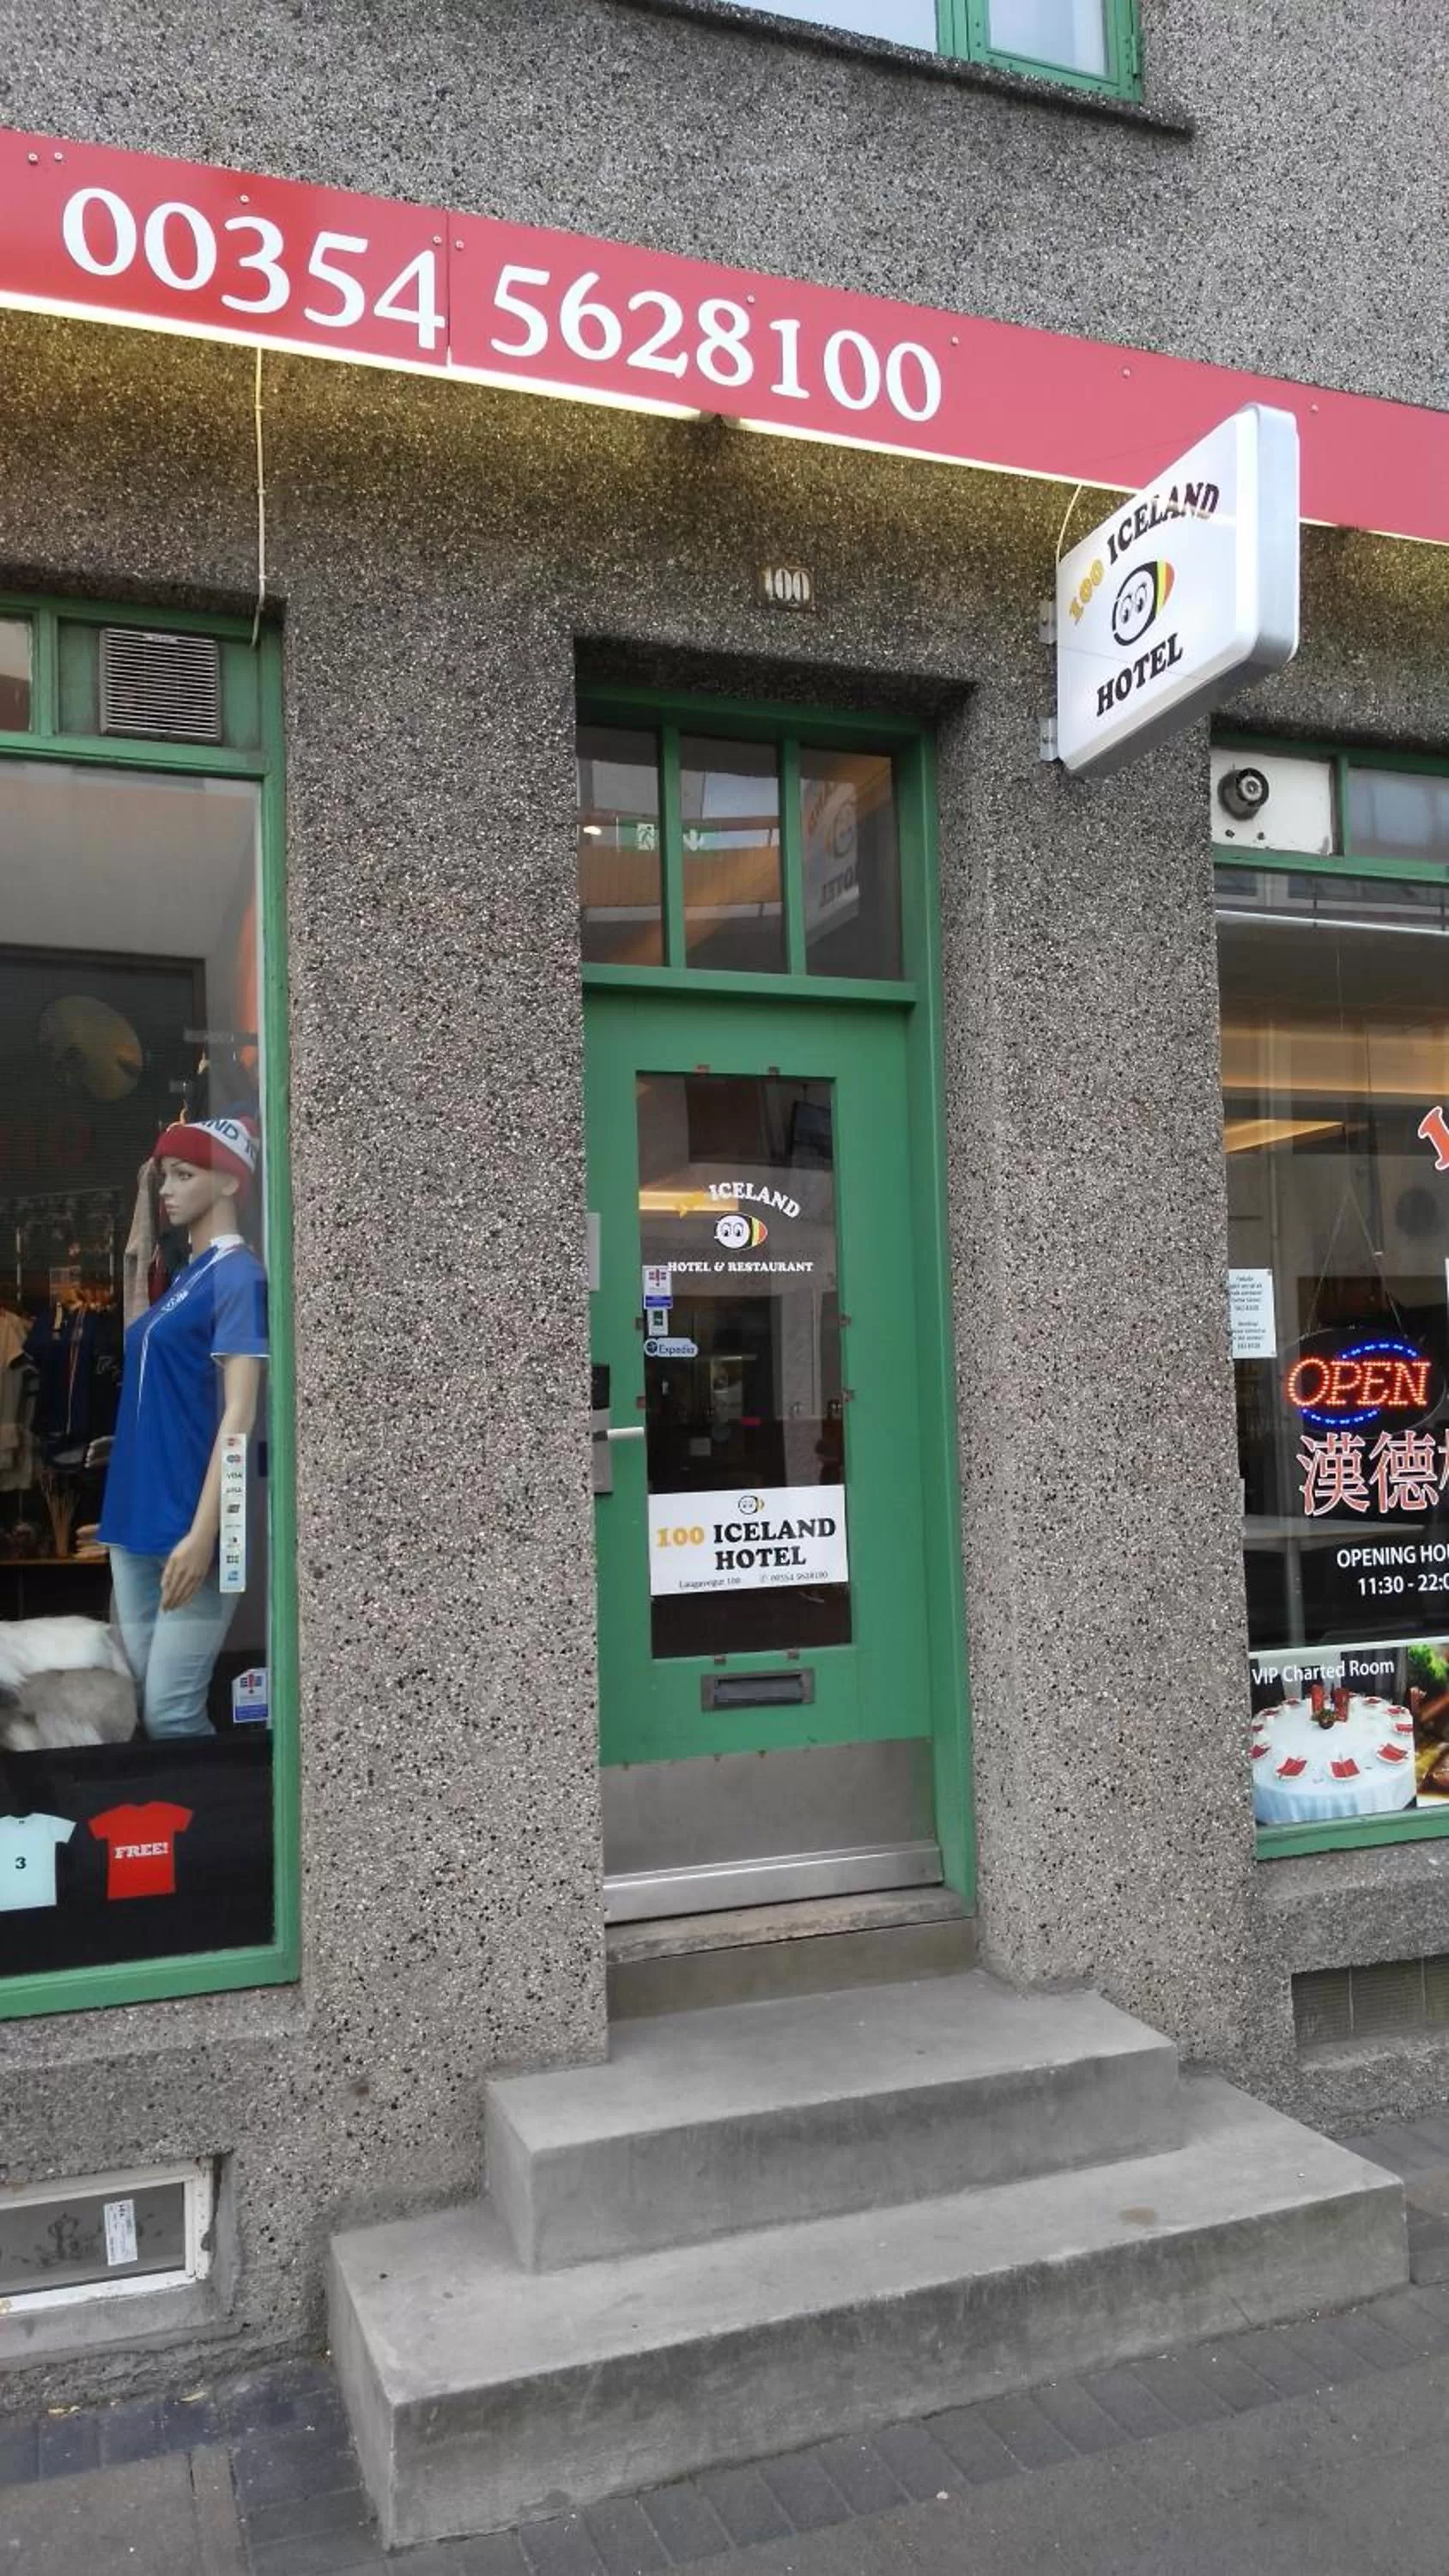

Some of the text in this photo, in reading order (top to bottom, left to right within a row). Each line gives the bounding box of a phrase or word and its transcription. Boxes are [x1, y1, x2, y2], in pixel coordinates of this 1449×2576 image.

[61, 186, 943, 423] 00354 5628100
[1070, 482, 1221, 625] 100 ICELAND
[1095, 632, 1184, 718] HOTEL
[708, 1182, 802, 1219] ICELAND
[668, 1261, 815, 1273] HOTEL & RESTAURANT
[658, 1344, 695, 1356] Expedia
[1288, 1358, 1432, 1406] OPEN
[1295, 1429, 1449, 1516] 漢德
[656, 1517, 837, 1548] 100 ICELAND
[714, 1546, 808, 1571] HOTEL
[1336, 1543, 1449, 1569] OPENING HO
[1357, 1575, 1404, 1596] 11:30
[1251, 1659, 1395, 1686] VIP Charted Room
[15, 1856, 27, 1870] 3
[114, 1842, 169, 1860] FREE!
